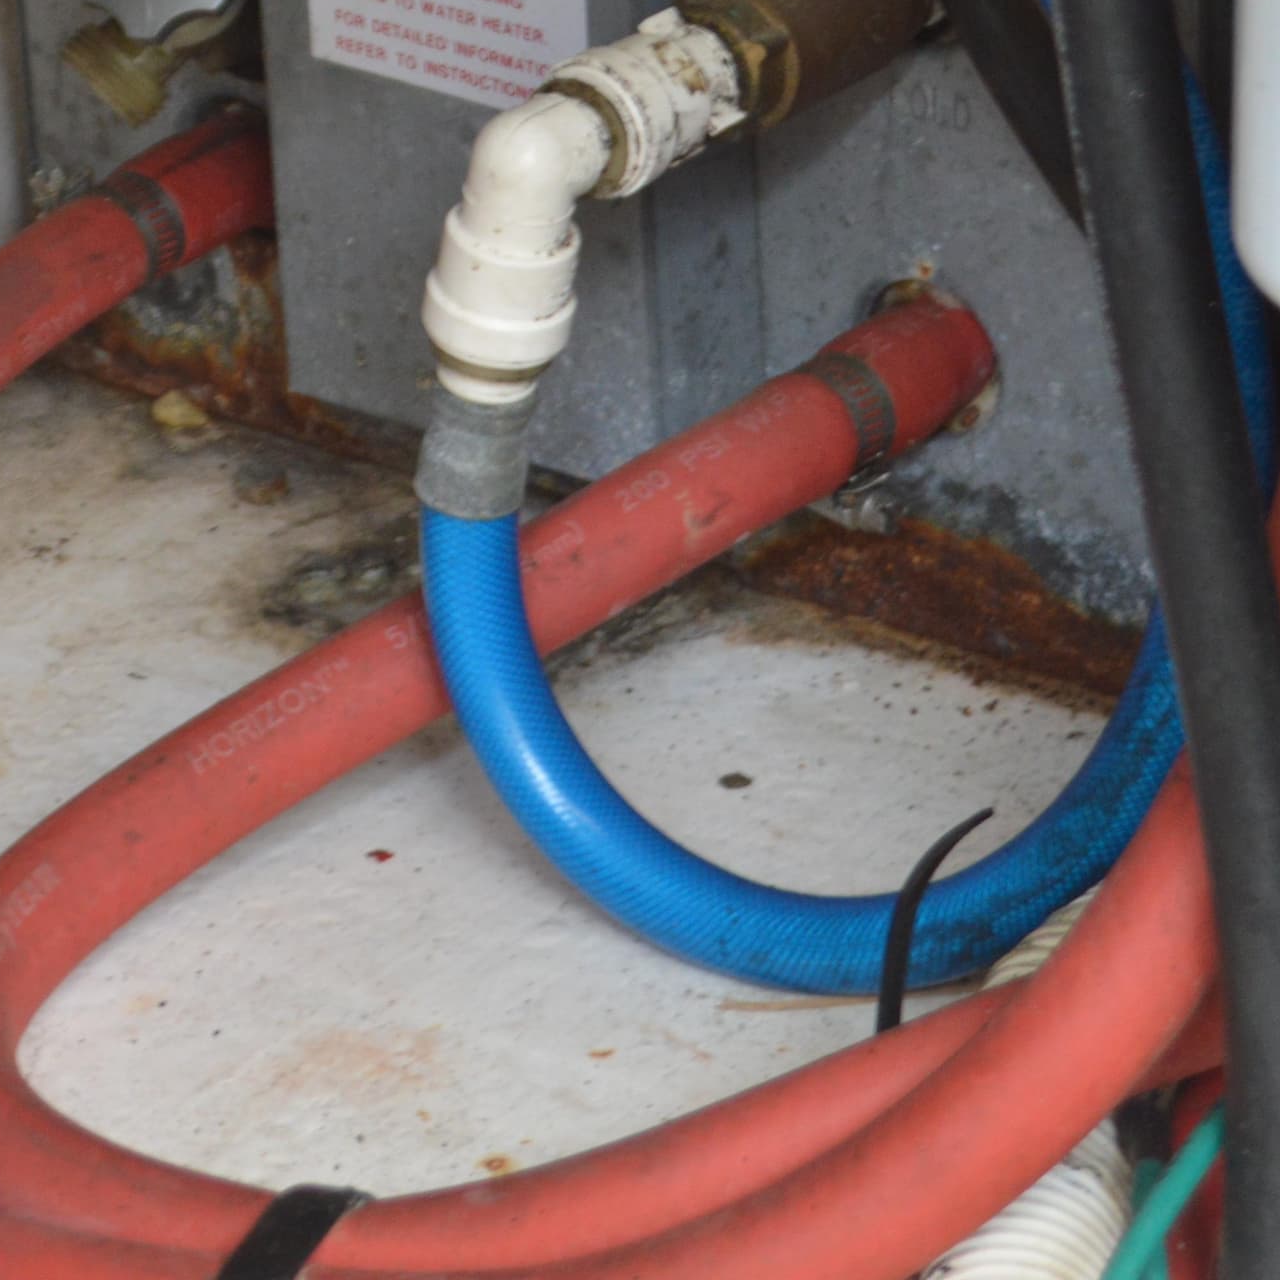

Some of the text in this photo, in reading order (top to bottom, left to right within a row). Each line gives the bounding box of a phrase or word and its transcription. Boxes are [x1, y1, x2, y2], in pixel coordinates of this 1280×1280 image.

[334, 9, 552, 78] FOR DETAILED INFORMATIO
[422, 0, 476, 27] WATER
[481, 15, 548, 46] HEATER.
[335, 35, 388, 60] REFER
[396, 52, 416, 71] TO
[616, 469, 671, 512] 200
[679, 431, 732, 472] PSI
